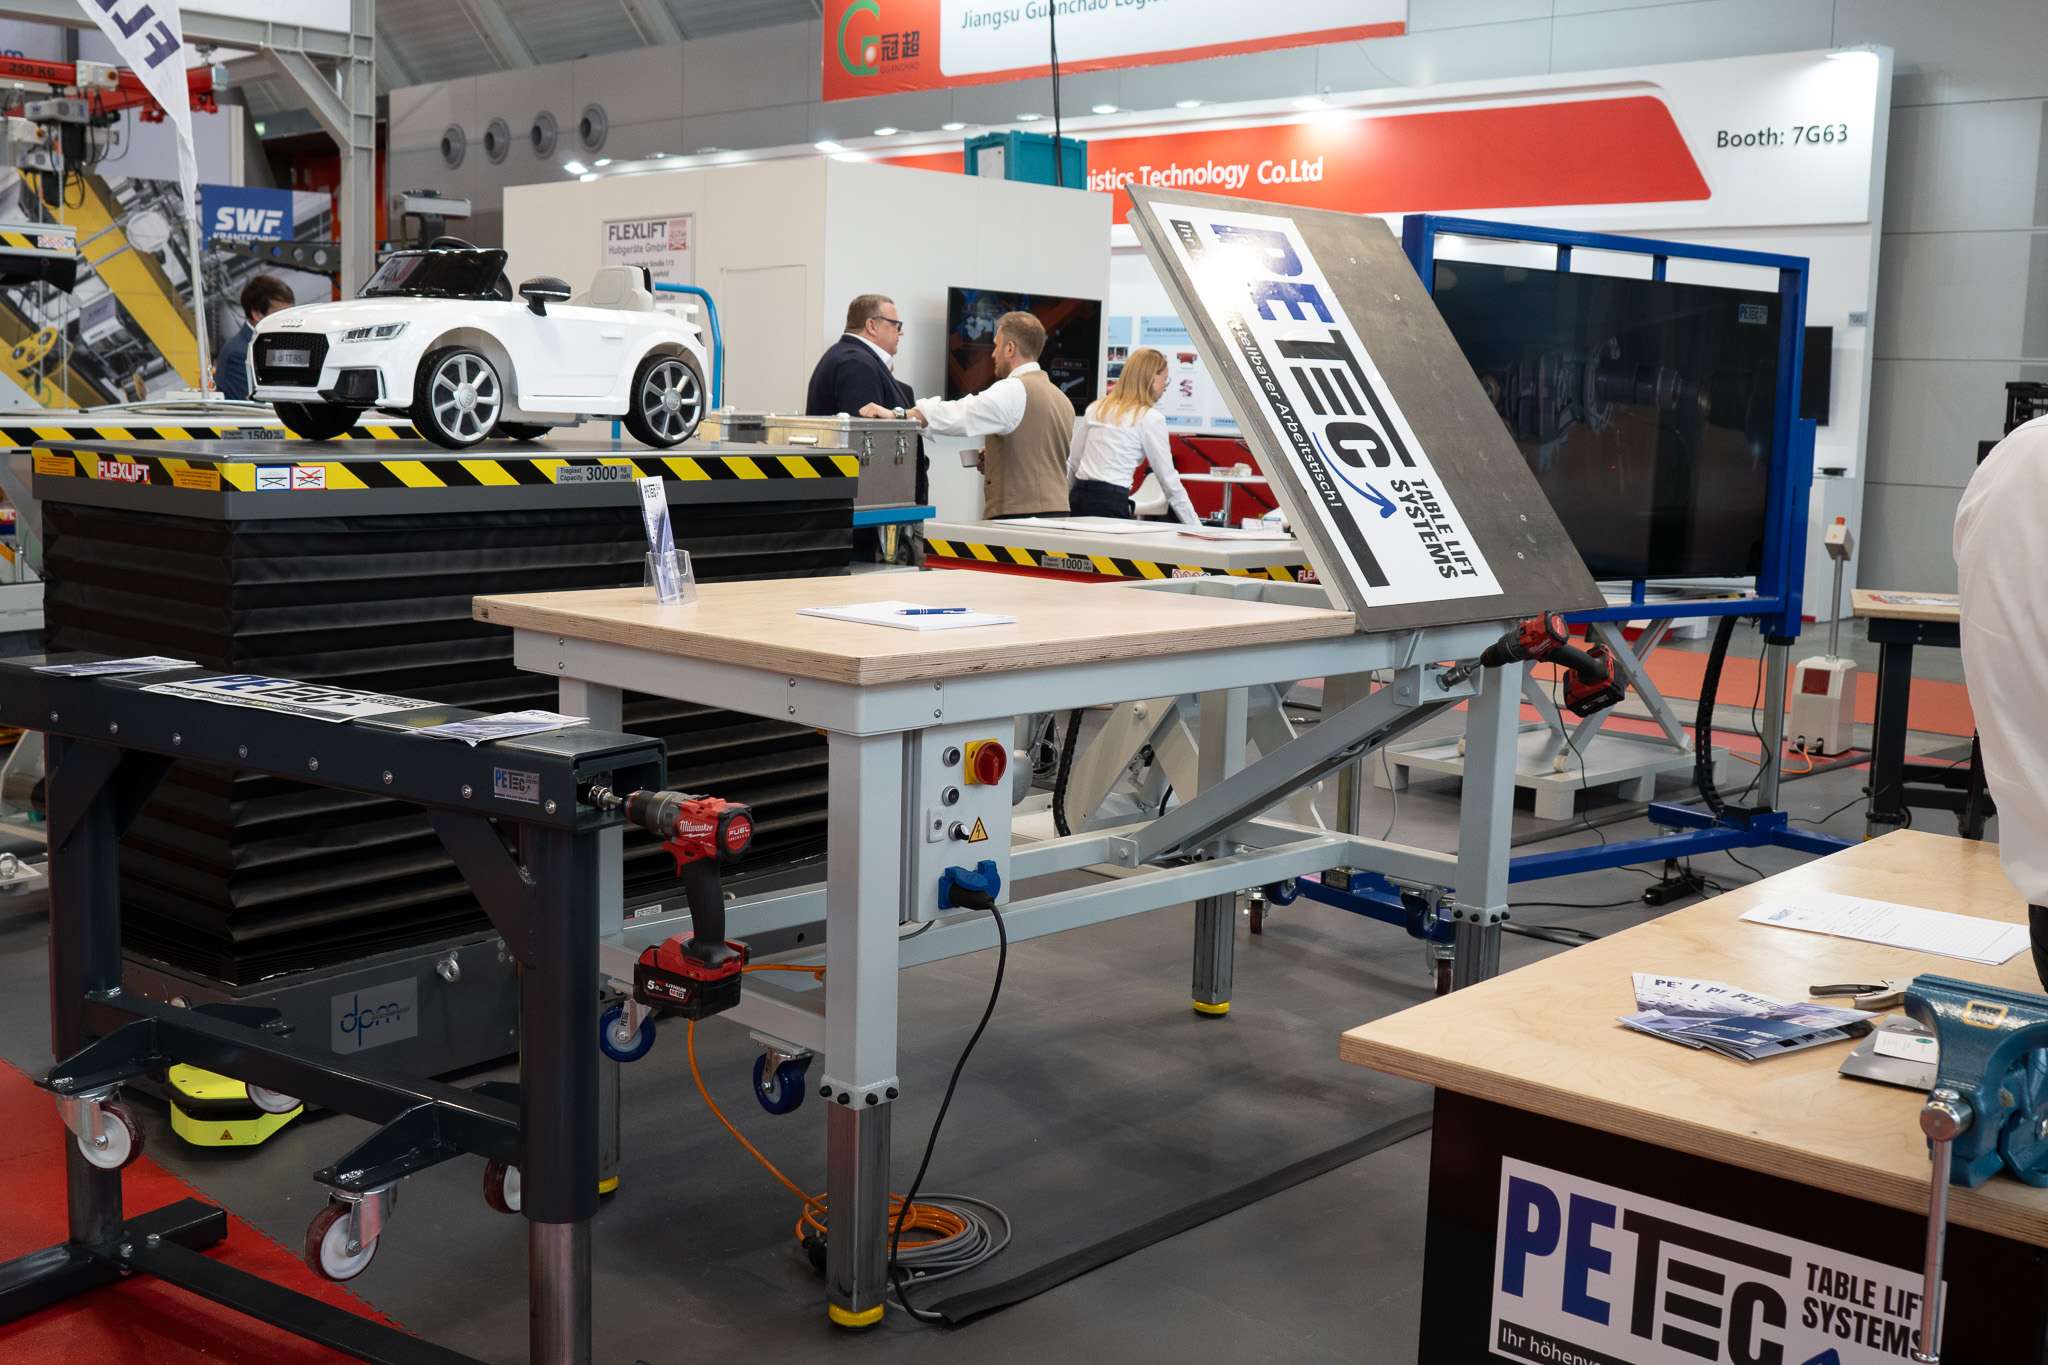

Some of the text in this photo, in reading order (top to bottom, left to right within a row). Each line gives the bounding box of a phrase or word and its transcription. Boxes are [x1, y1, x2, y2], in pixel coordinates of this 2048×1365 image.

[962, 8, 1020, 30] Jiangsu
[881, 30, 920, 62] 冠超
[1717, 124, 1848, 149] Booth: 7G63
[1087, 156, 1324, 192] istics Technology Co.Ltd
[215, 206, 284, 234] SWF
[608, 221, 667, 241] FLEXLIFT
[1176, 222, 1197, 244] Ihr
[1275, 402, 1342, 507] Arbeitstisch!
[98, 461, 150, 482] FLEXLIFT
[586, 466, 618, 480] 3000
[1390, 479, 1459, 579] SYSTEMS
[1411, 478, 1479, 577] TABLE LIFT
[1062, 558, 1083, 570] 1000
[495, 769, 526, 792] PETEC
[680, 819, 714, 833] Milwaukee
[728, 825, 751, 837] FUEL
[1501, 1175, 1793, 1365] PETEC
[1806, 1262, 1924, 1321] TABLE LIF
[1502, 1327, 1526, 1348] Ihr
